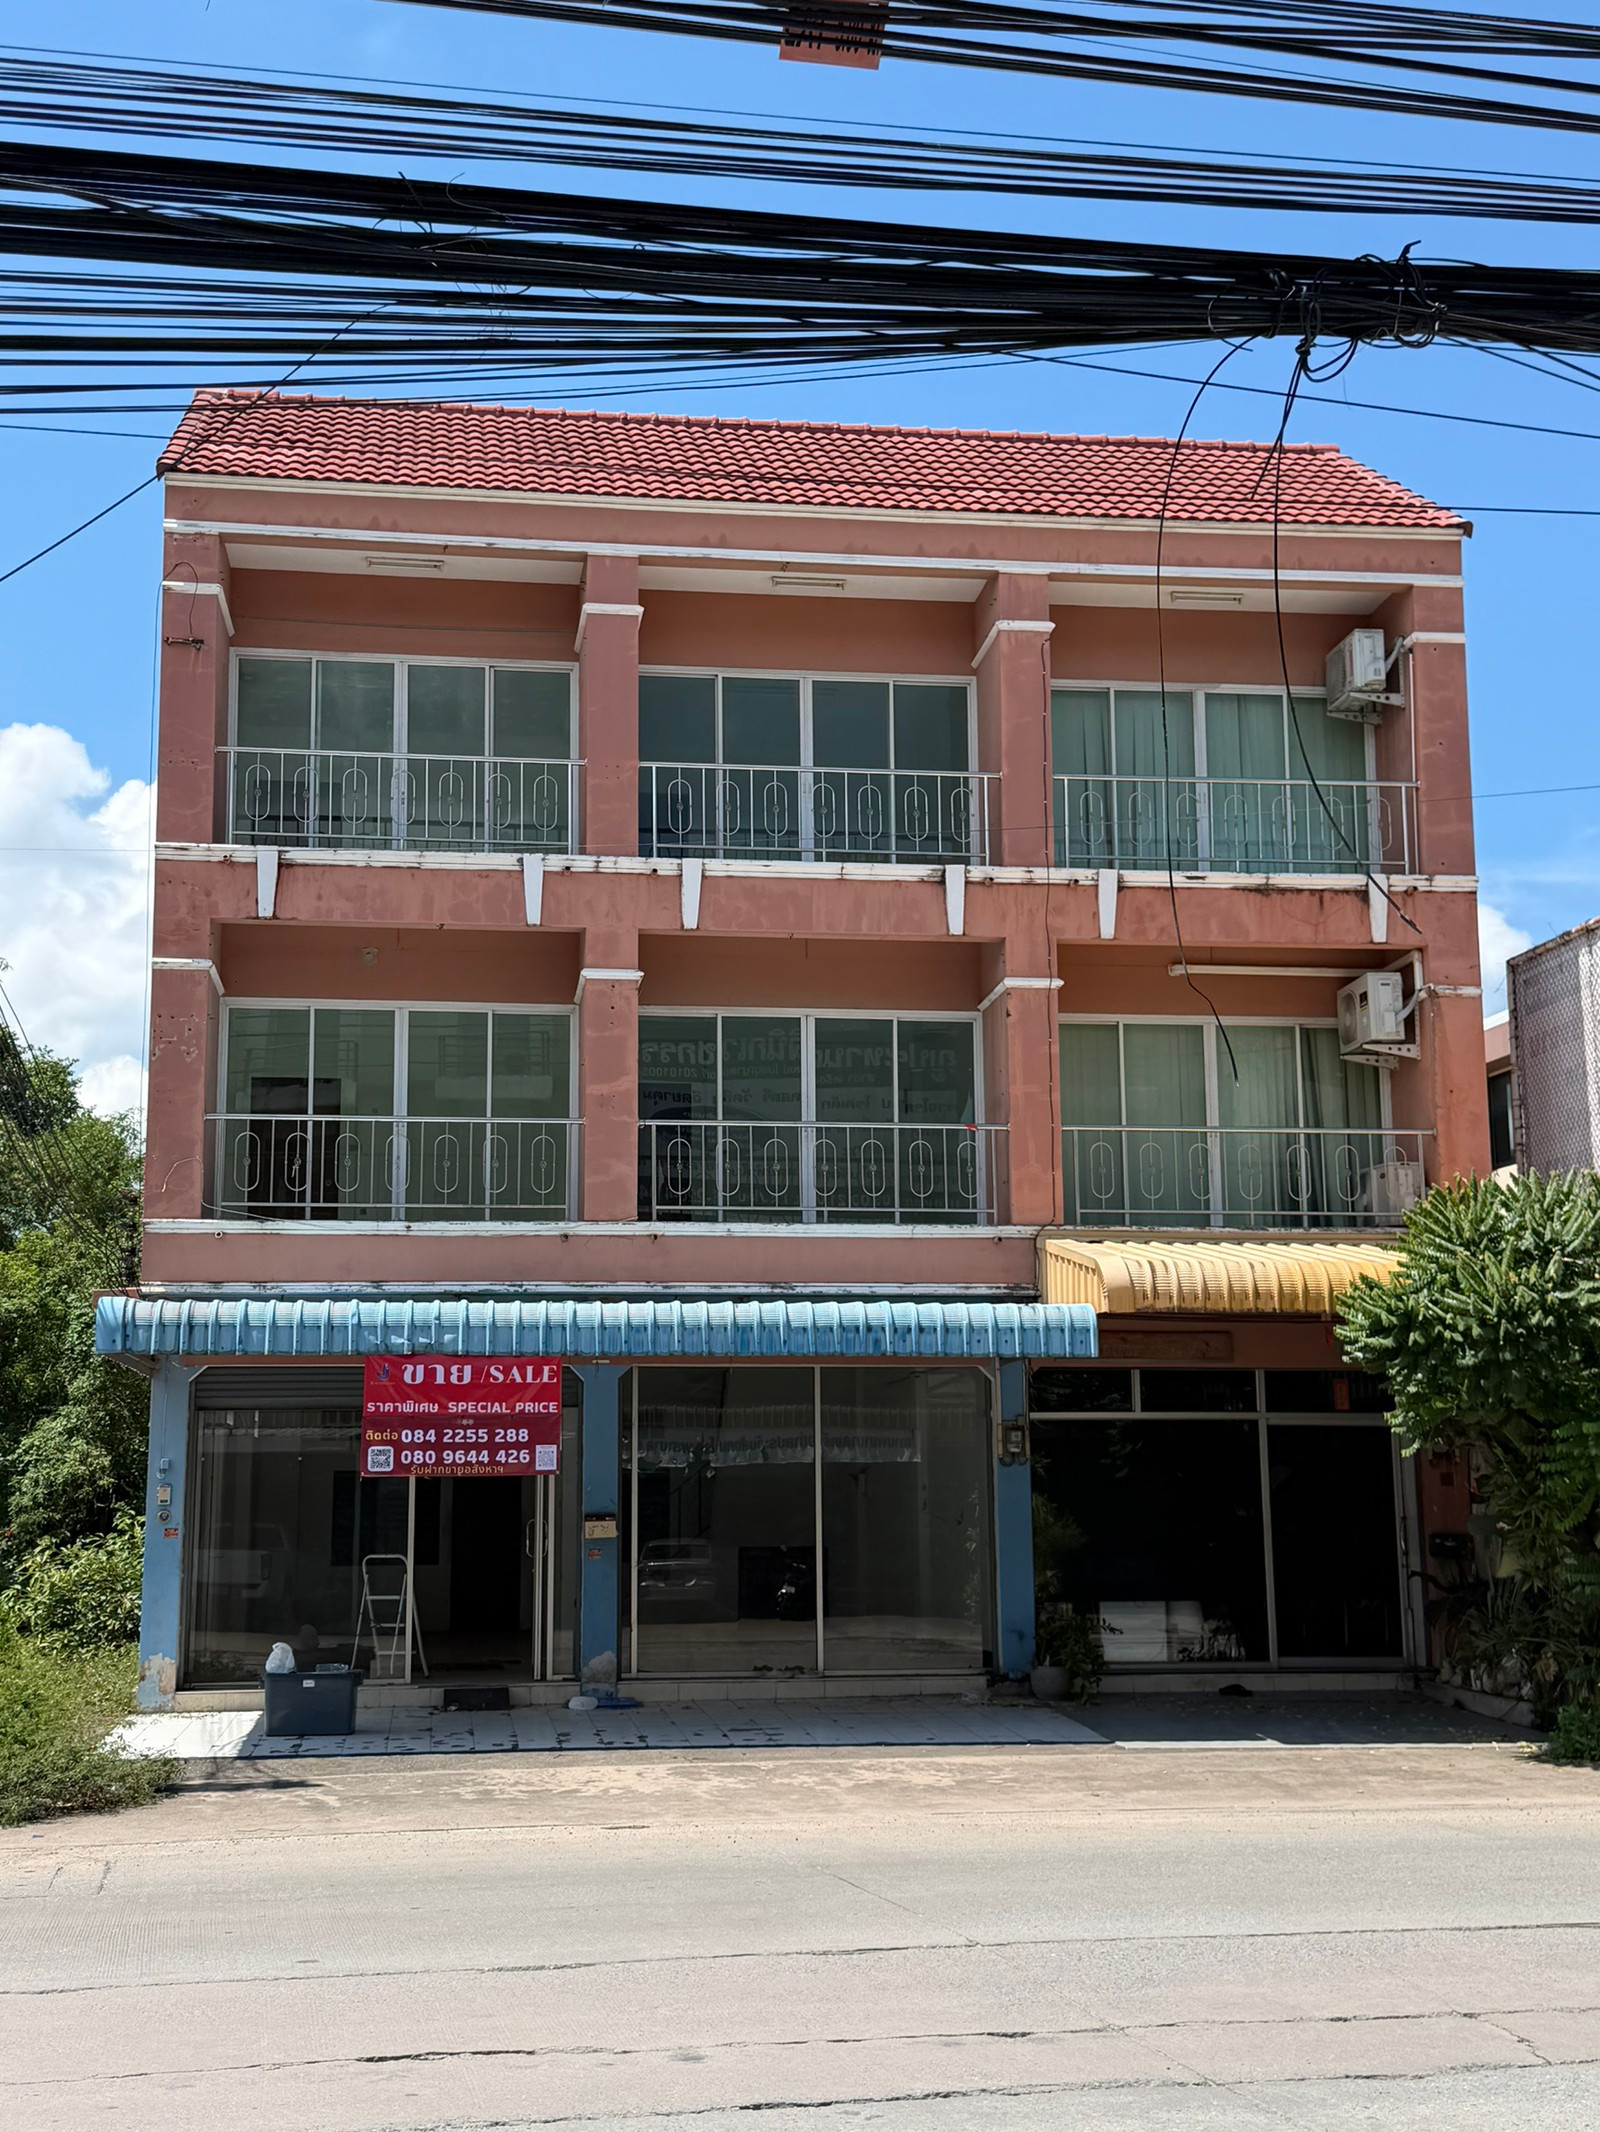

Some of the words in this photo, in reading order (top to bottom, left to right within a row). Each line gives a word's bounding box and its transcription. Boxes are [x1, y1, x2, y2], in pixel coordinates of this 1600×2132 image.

[401, 1363, 473, 1385] ขาย
[366, 1400, 439, 1413] ราคาพิเศษ
[448, 1402, 511, 1413] SPECIAL
[515, 1402, 558, 1413] PRICE
[365, 1428, 399, 1441] ติดต่อ
[401, 1429, 436, 1443] 084
[442, 1429, 488, 1443] 2255
[494, 1428, 529, 1443] 288
[400, 1450, 436, 1464] 080
[442, 1449, 490, 1464] 9644
[495, 1449, 530, 1464] 426
